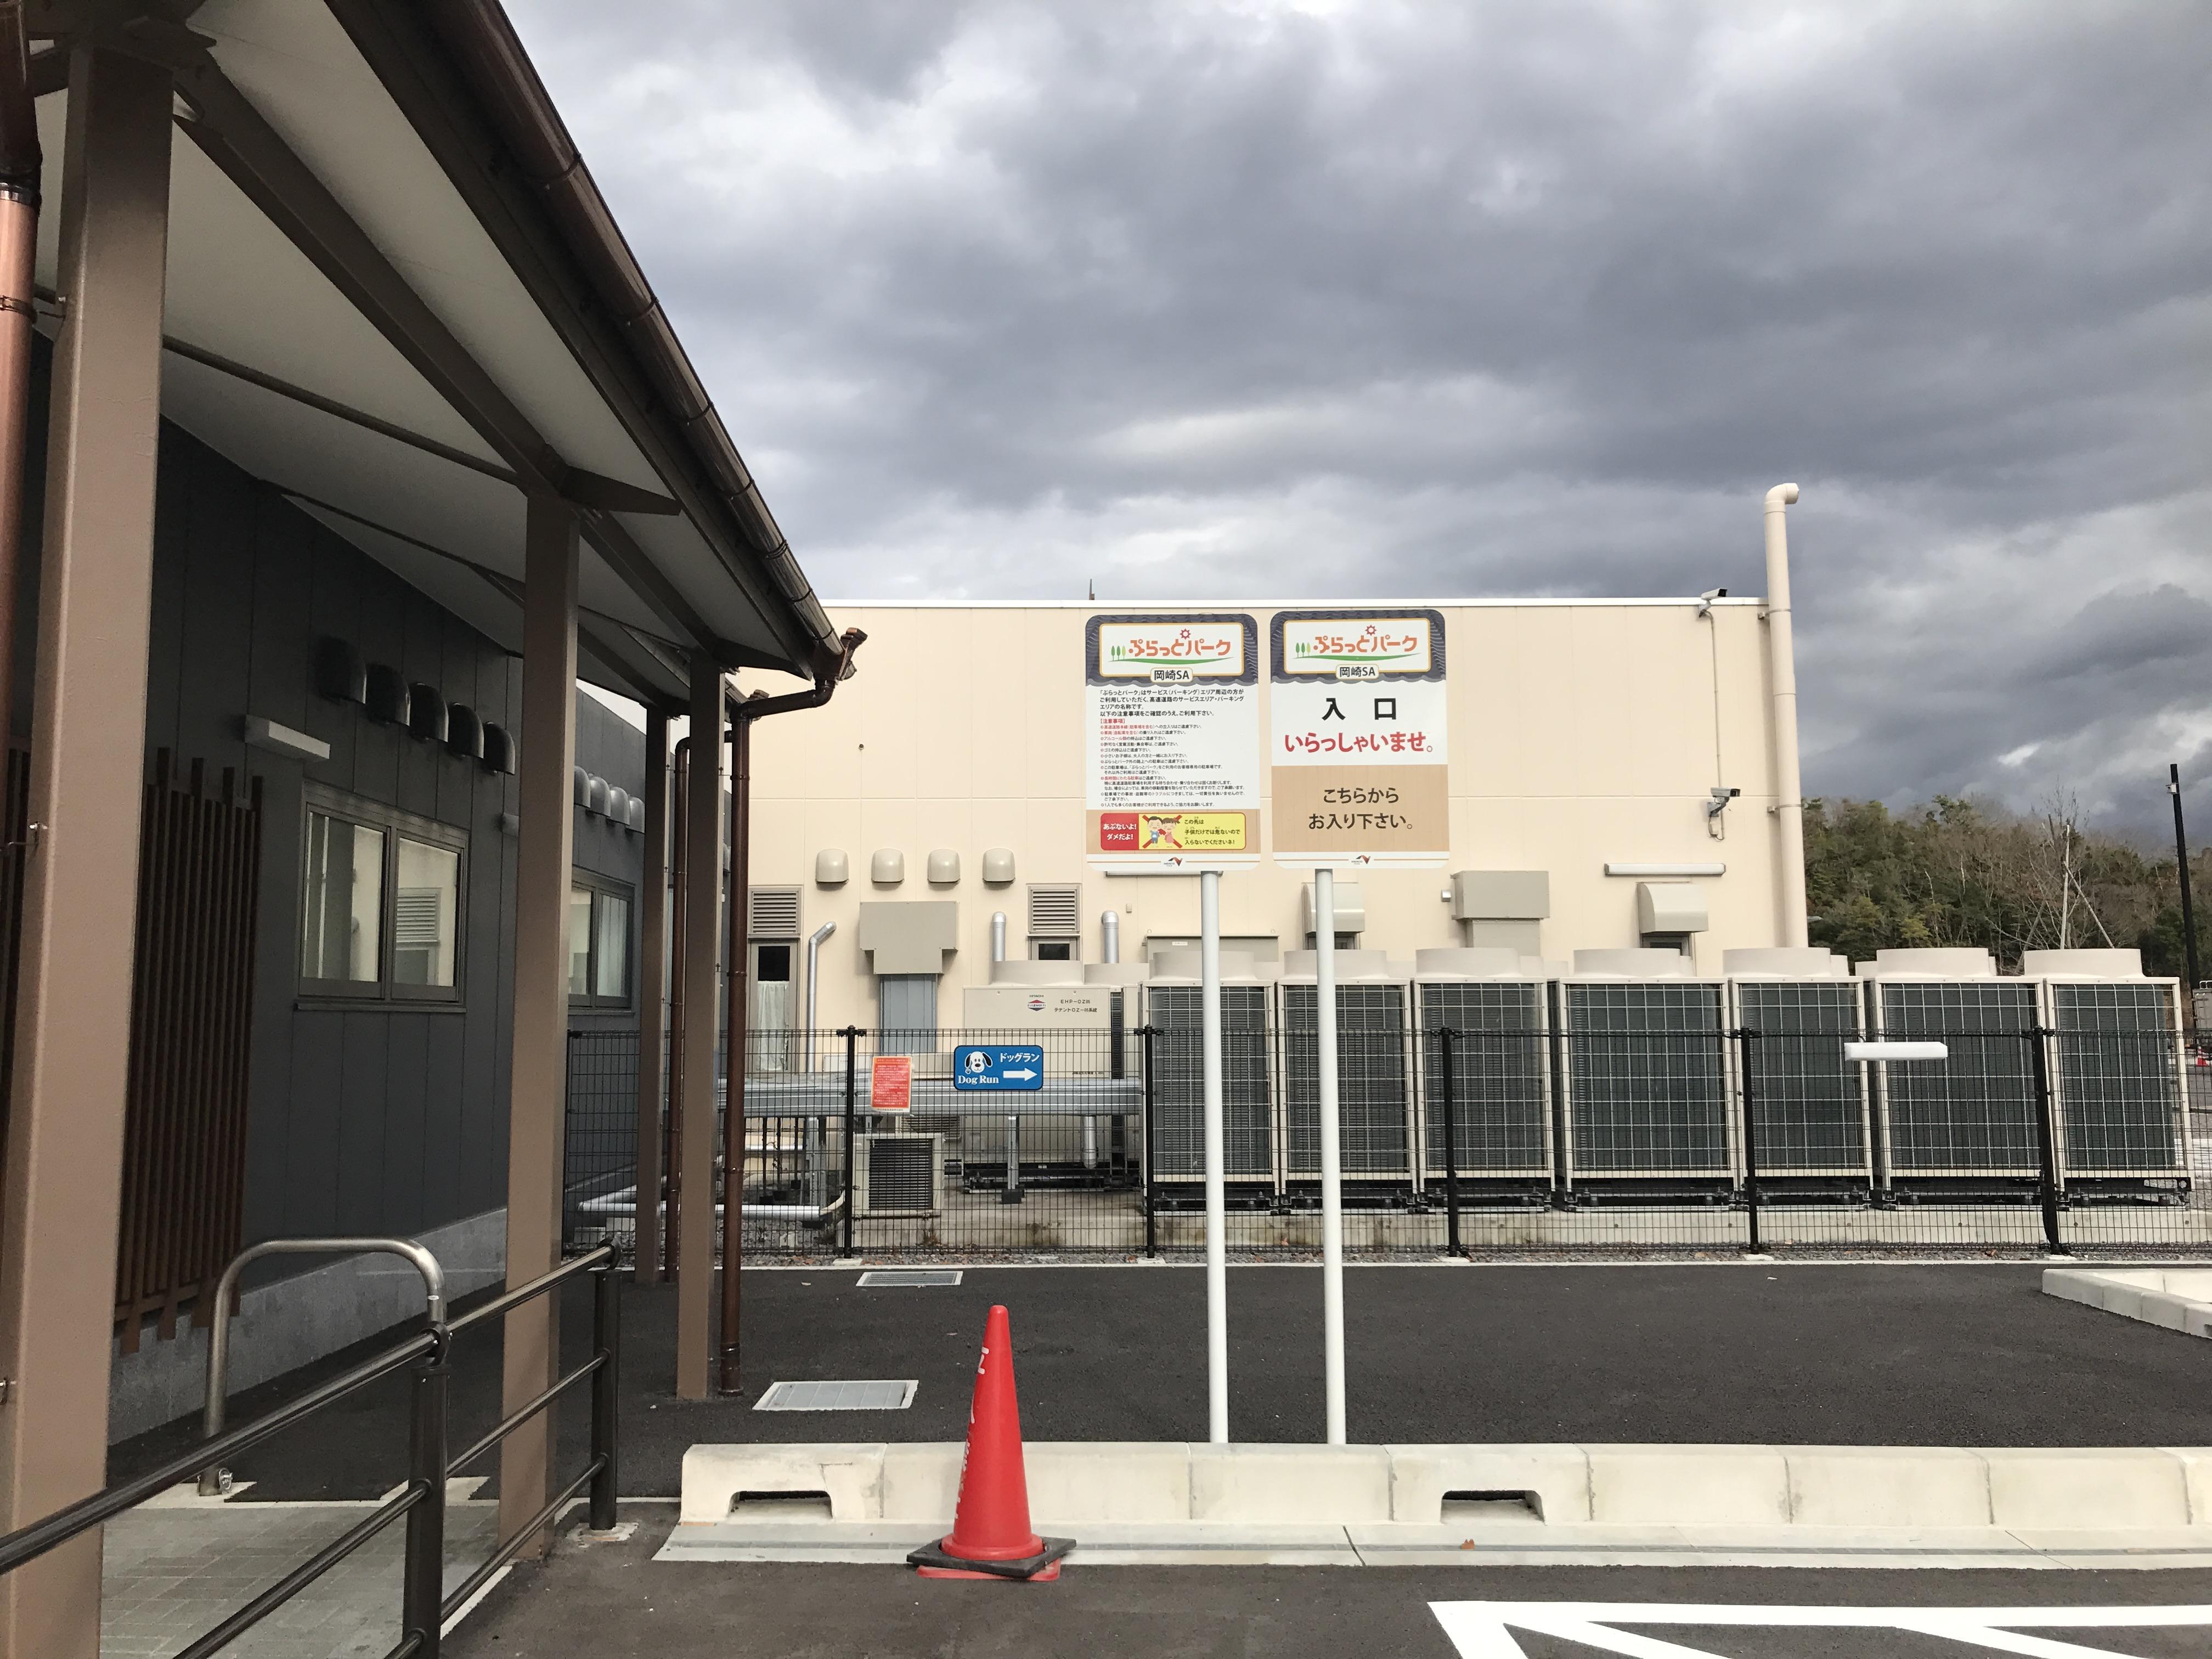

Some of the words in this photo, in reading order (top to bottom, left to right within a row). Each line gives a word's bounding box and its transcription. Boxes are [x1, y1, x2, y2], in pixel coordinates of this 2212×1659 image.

[1128, 638, 1231, 657] ぷらっとパーク
[1313, 634, 1418, 653] ぷらっとパーク
[1154, 670, 1190, 681] 岡崎SA
[1339, 667, 1376, 677] 岡崎SA
[1284, 731, 1433, 753] いらっしゃいませ。
[1323, 787, 1400, 804] こちらから
[1308, 812, 1413, 830] お入り下さい。
[1000, 1053, 1040, 1063] ドッグラン
[958, 1075, 978, 1085] Dog
[979, 1075, 999, 1084] Run
